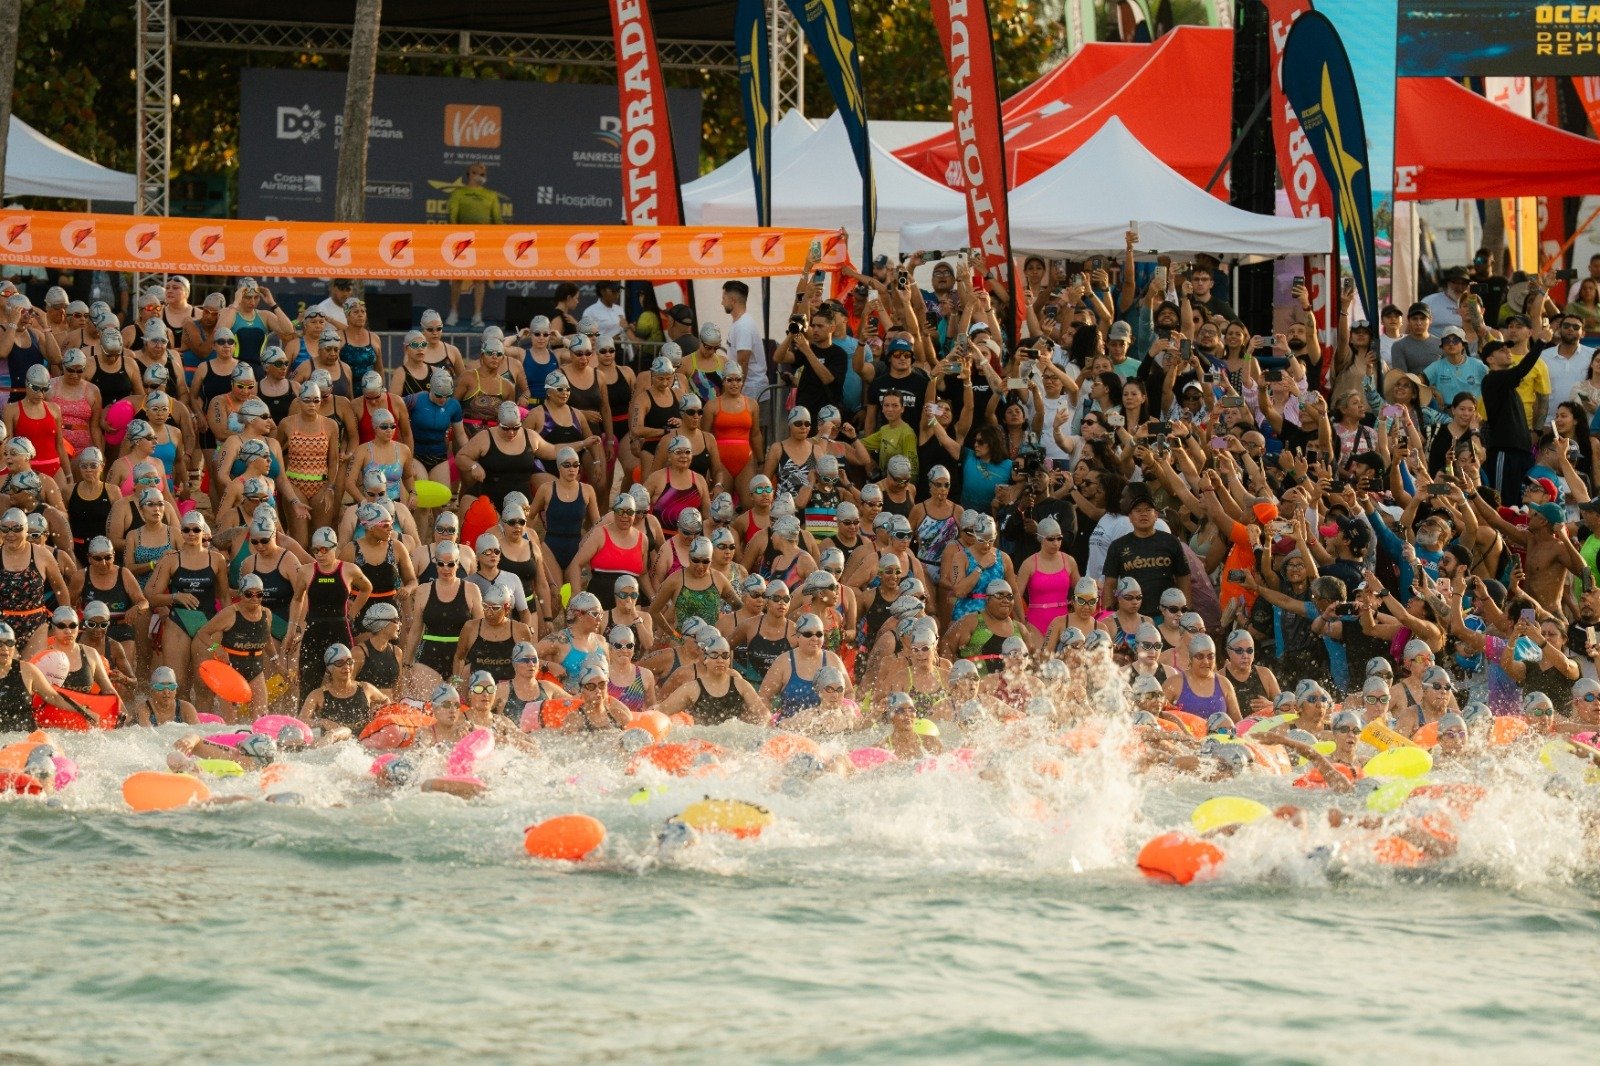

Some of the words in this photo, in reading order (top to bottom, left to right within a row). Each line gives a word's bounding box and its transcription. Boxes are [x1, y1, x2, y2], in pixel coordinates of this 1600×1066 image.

[260, 181, 303, 192] Airlines
[555, 194, 612, 208] Hospiten
[50, 257, 112, 268] GATORADE
[115, 260, 177, 271] GATORADE
[179, 263, 241, 273] GATORADE
[243, 266, 304, 275] GATORADE
[306, 268, 367, 276] GATORADE
[369, 268, 430, 277] GATORADE
[431, 269, 491, 277] GATORADE
[494, 269, 554, 277] GATORADE
[555, 269, 615, 277] GATORADE
[617, 268, 677, 277] GATORADE
[679, 267, 738, 276] GATORADE
